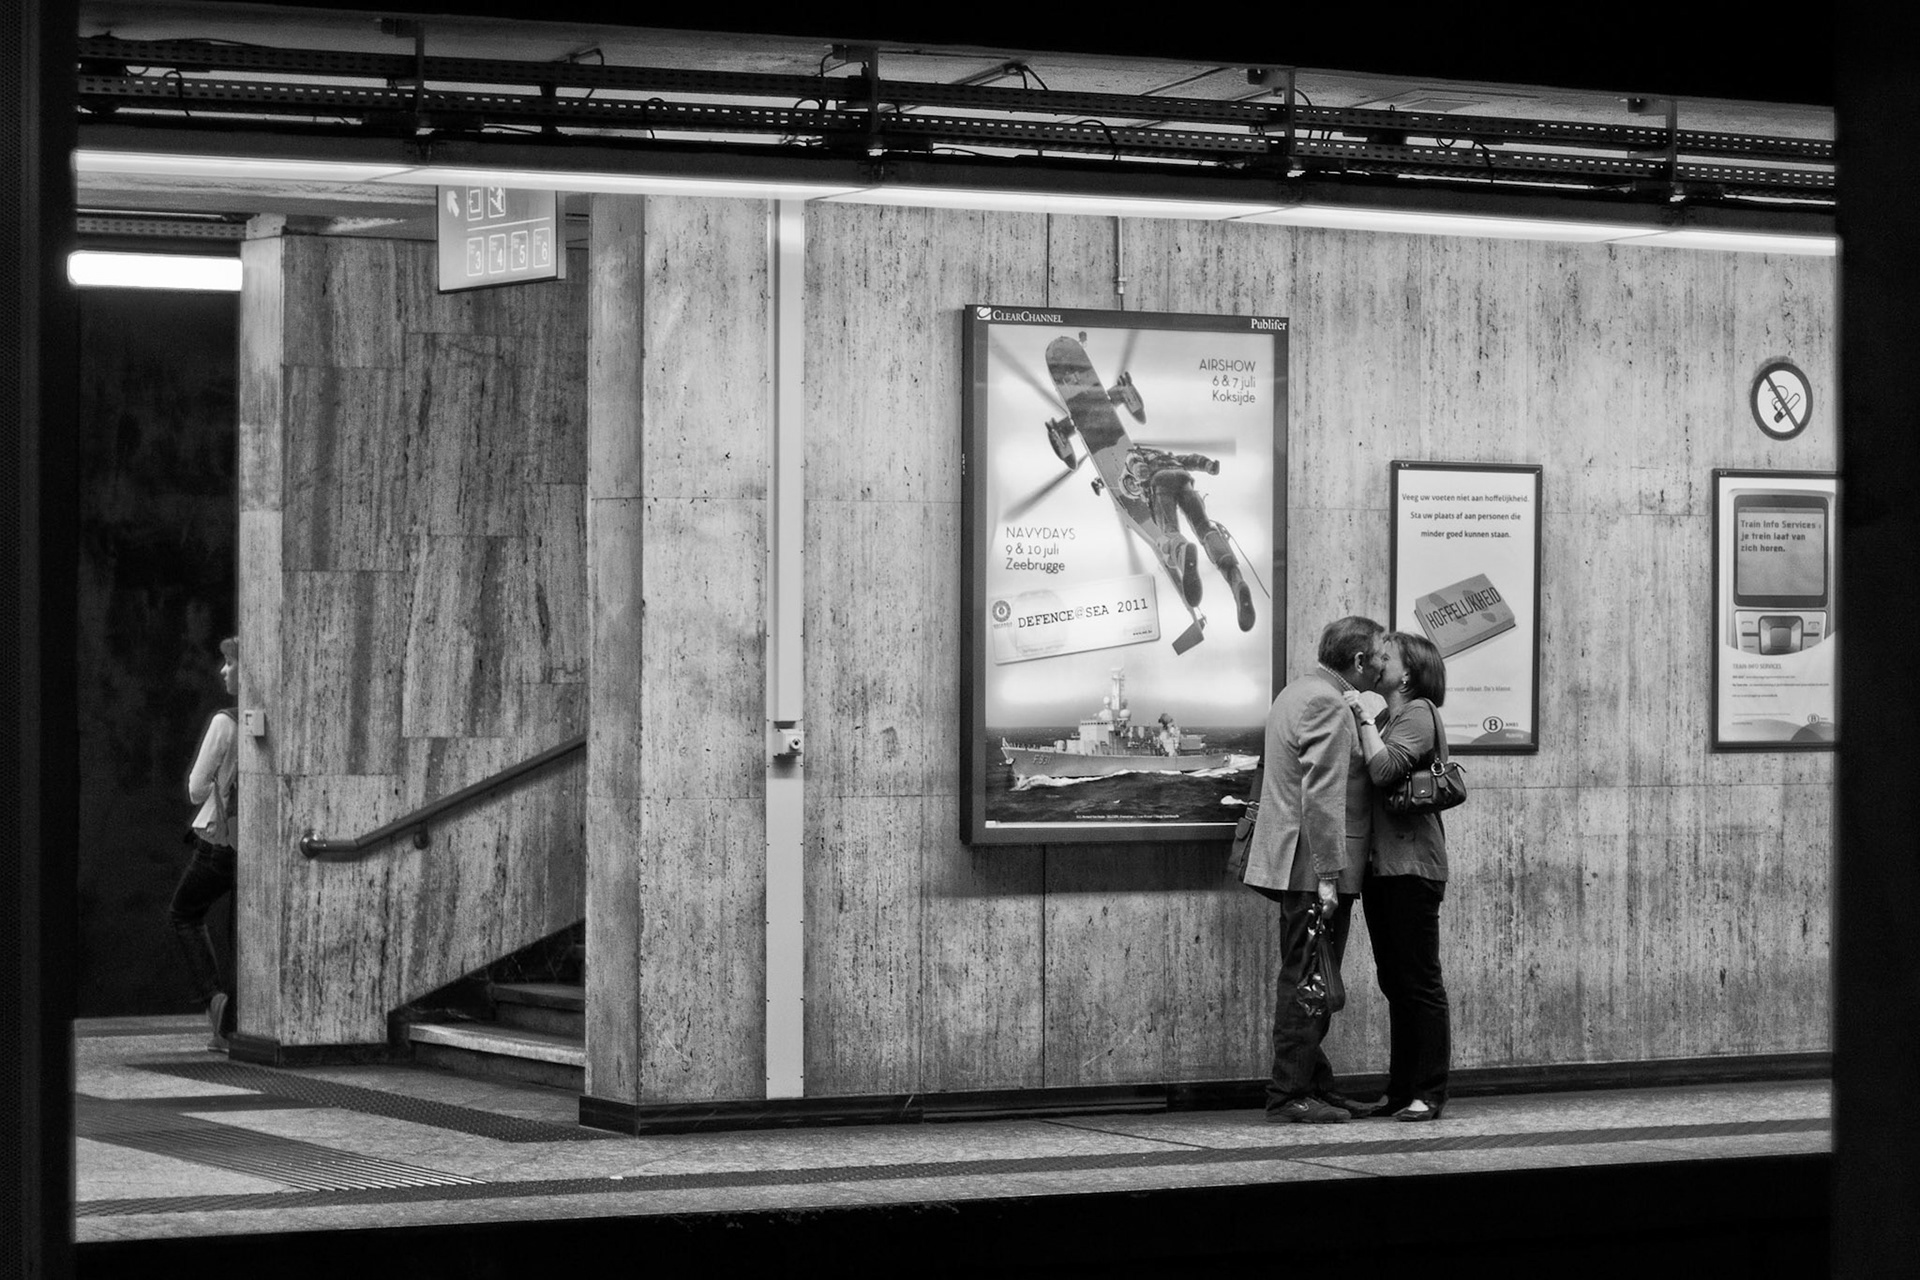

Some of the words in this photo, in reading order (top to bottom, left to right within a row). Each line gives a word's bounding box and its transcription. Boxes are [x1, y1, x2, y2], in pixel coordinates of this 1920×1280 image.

[475, 250, 481, 270] 3
[497, 248, 503, 267] 4
[519, 244, 526, 264] 5
[541, 241, 548, 261] 6
[1250, 318, 1287, 331] Publifer
[1199, 358, 1256, 373] AIRSHOW
[1212, 375, 1220, 386] 6
[1221, 375, 1230, 386] &
[1232, 378, 1239, 389] 7
[1239, 376, 1257, 391] juli
[1212, 389, 1256, 405] Koksijde
[1401, 493, 1419, 503] Veeg
[1420, 494, 1430, 502] uw
[1431, 494, 1455, 502] voeten
[1456, 493, 1470, 503] niet
[1471, 495, 1484, 503] aan
[1410, 511, 1422, 520] Sta
[1434, 511, 1455, 522] plaats
[1456, 512, 1464, 520] af
[1464, 513, 1477, 521] aan
[1478, 513, 1510, 522] personen
[1511, 512, 1522, 521] die
[1741, 520, 1761, 529] Train
[1763, 520, 1780, 529] Info
[1782, 521, 1816, 529] Services
[1005, 526, 1077, 541] NAVYDAYS
[1421, 530, 1445, 539] minder
[1446, 530, 1464, 540] goed
[1464, 530, 1490, 539] kunnen
[1491, 531, 1512, 539] staan.
[1741, 533, 1749, 541] je
[1752, 532, 1771, 540] trein
[1773, 532, 1789, 540] laat
[1005, 545, 1012, 556] 9
[1014, 543, 1025, 555] &
[1027, 545, 1042, 556] 10
[1042, 543, 1060, 558] juli
[1741, 544, 1758, 552] zich
[1760, 544, 1786, 552] horen.
[1005, 557, 1066, 575] Zeebrugge
[1116, 597, 1149, 614] 2011
[1425, 586, 1502, 630] HOFFELIJKHEID
